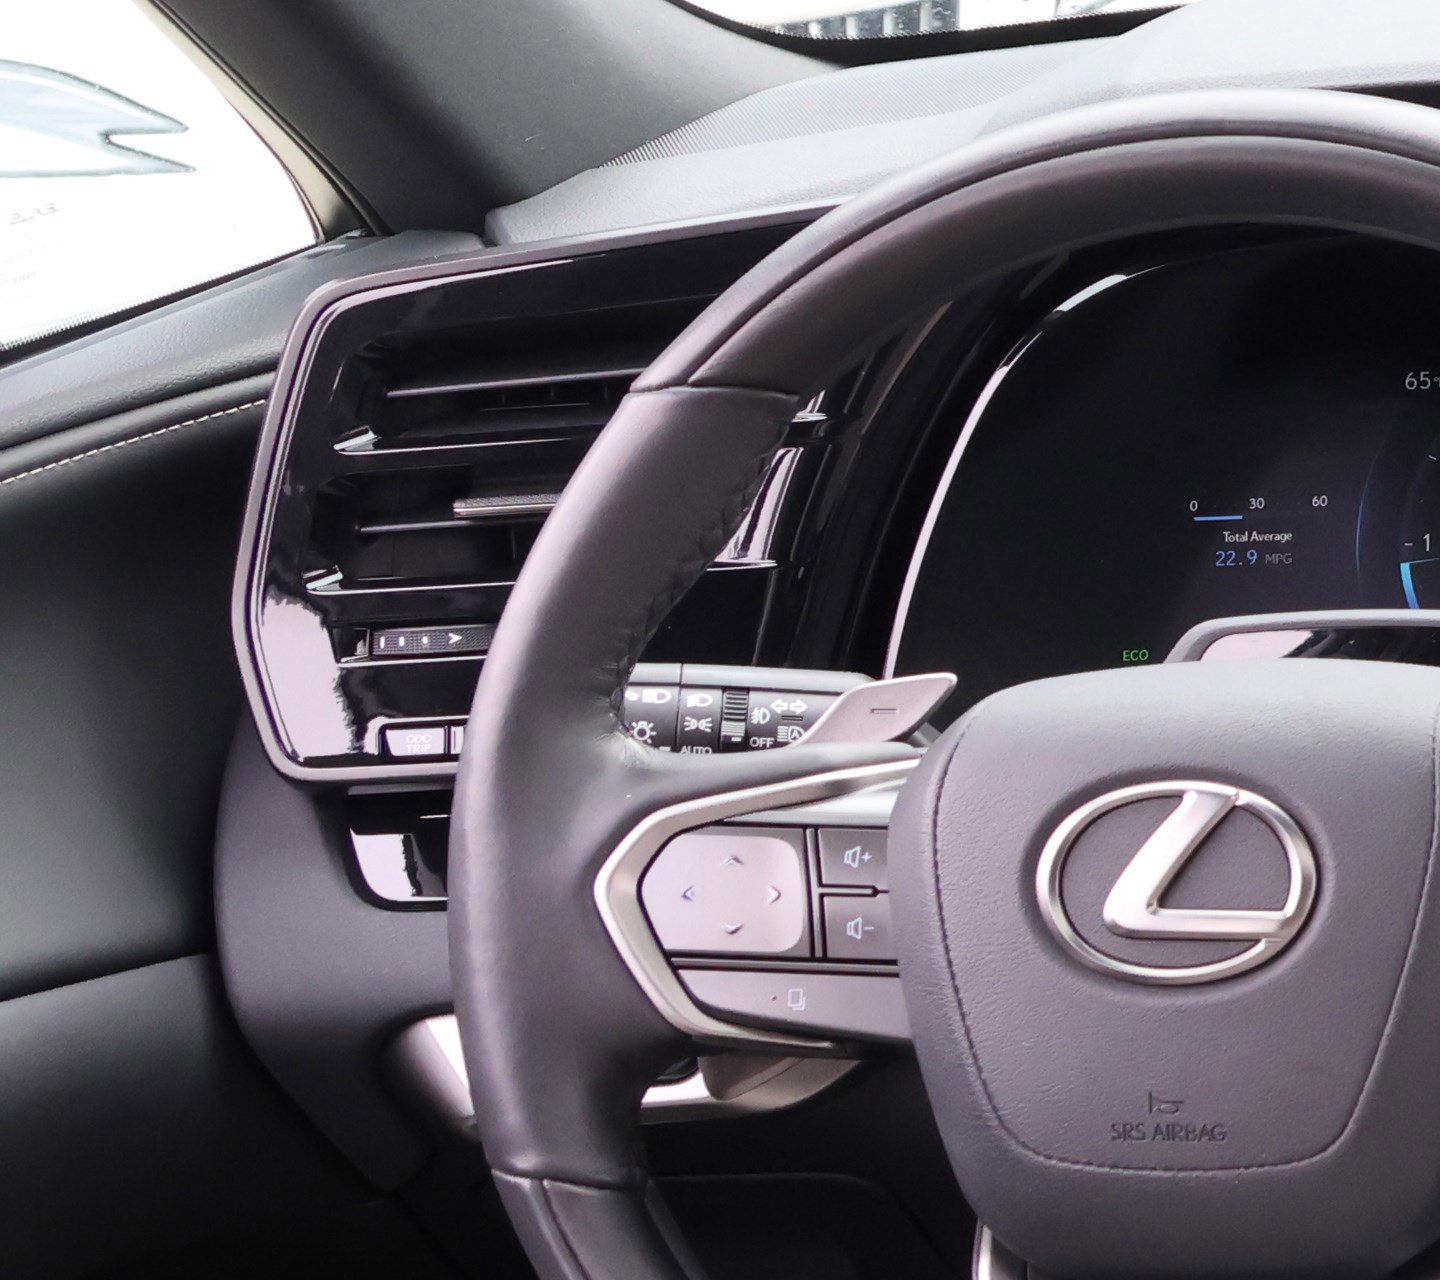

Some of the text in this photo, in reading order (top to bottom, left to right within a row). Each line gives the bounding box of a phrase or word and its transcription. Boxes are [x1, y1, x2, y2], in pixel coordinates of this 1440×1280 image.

[1189, 495, 1329, 512] 0 30 60
[1223, 531, 1293, 543] Total Average
[1422, 533, 1431, 552] 1
[1215, 549, 1293, 567] 22.9 MPG
[1122, 649, 1149, 662] ECO
[406, 734, 432, 744] ODO
[750, 737, 776, 749] OFF
[406, 744, 432, 754] TRIP
[680, 745, 712, 754] AUTO
[1111, 1122, 1227, 1142] SRS AIRBAG
